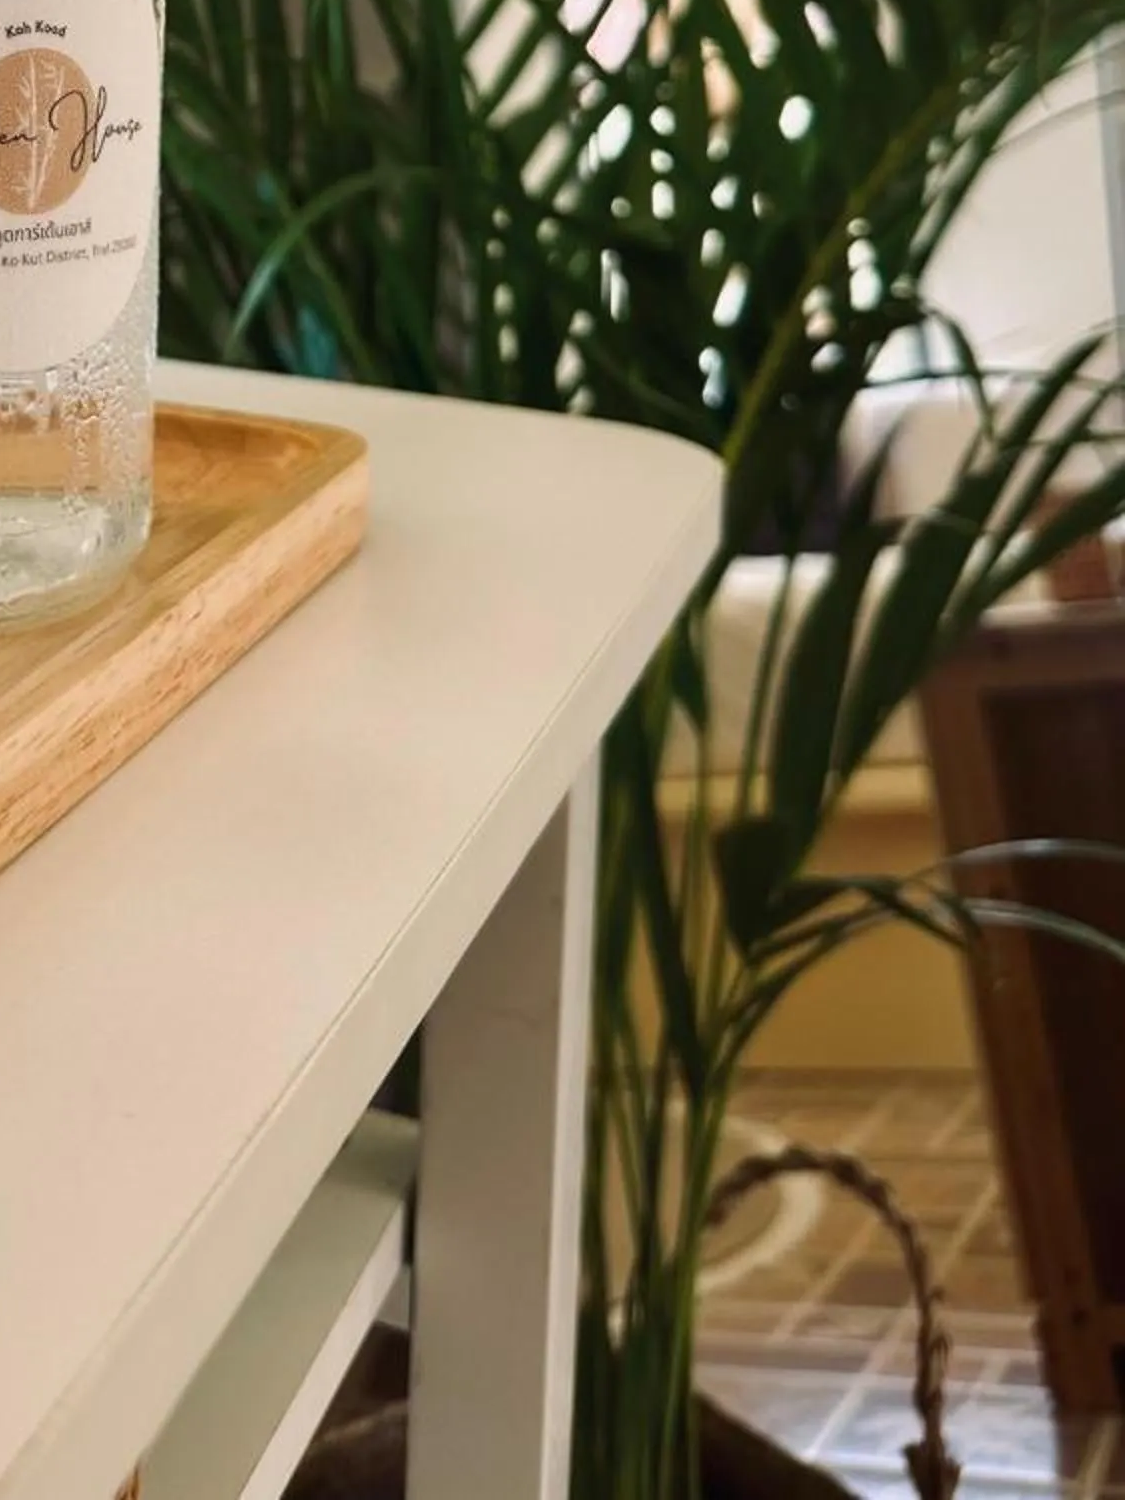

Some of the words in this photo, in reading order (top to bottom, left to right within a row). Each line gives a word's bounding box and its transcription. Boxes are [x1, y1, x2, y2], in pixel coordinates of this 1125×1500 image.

[5, 21, 32, 39] Koh
[34, 19, 68, 38] Kood
[49, 85, 143, 173] House
[22, 251, 43, 266] Kut
